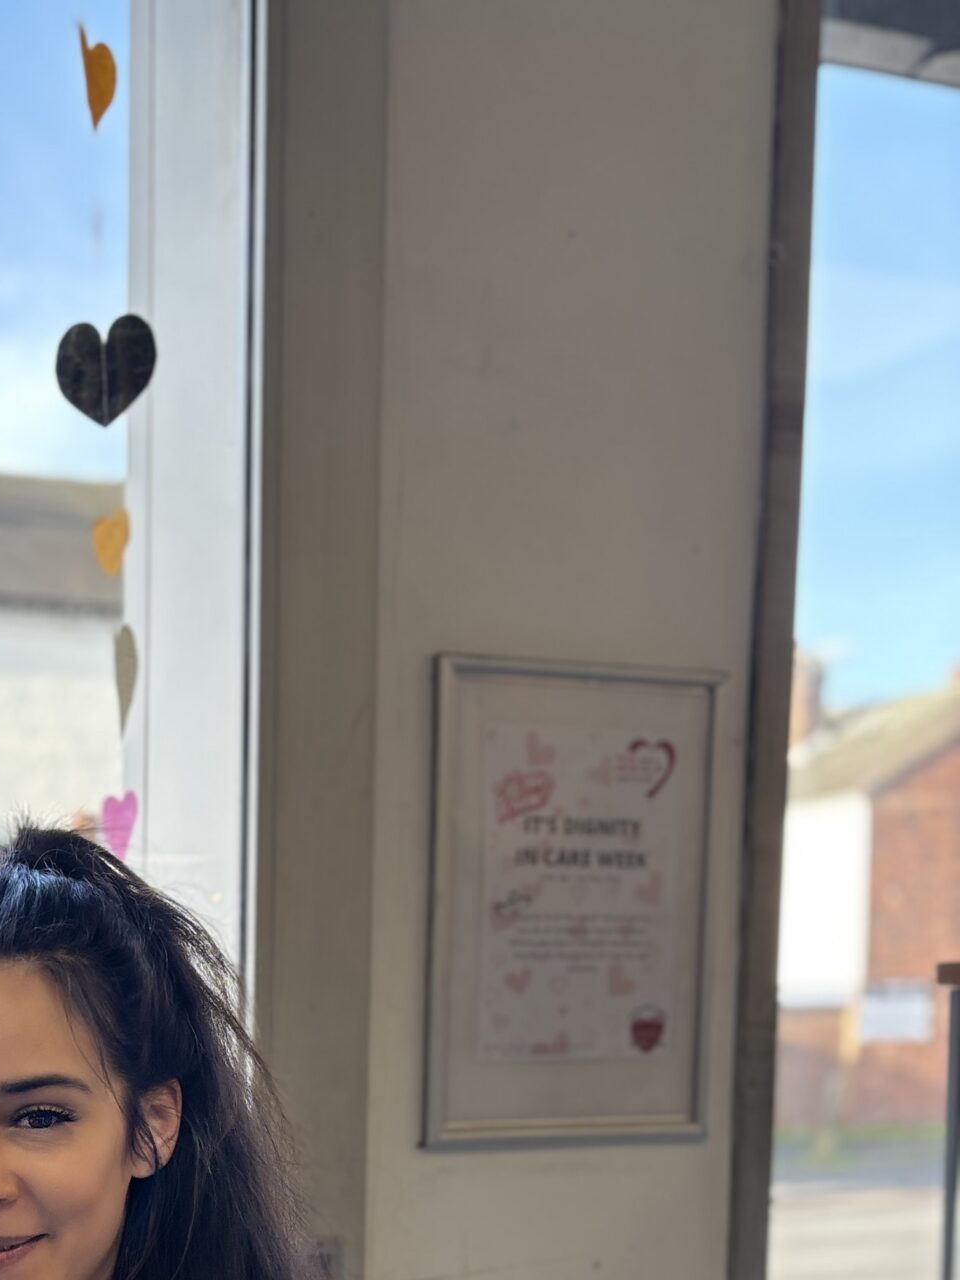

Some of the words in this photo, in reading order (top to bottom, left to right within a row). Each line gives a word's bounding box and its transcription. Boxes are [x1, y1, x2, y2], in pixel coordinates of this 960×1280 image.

[522, 815, 556, 835] IT'S
[562, 816, 641, 838] DIGNITY
[514, 848, 539, 867] IN
[542, 848, 591, 869] CARE
[597, 849, 647, 870] WEEK
